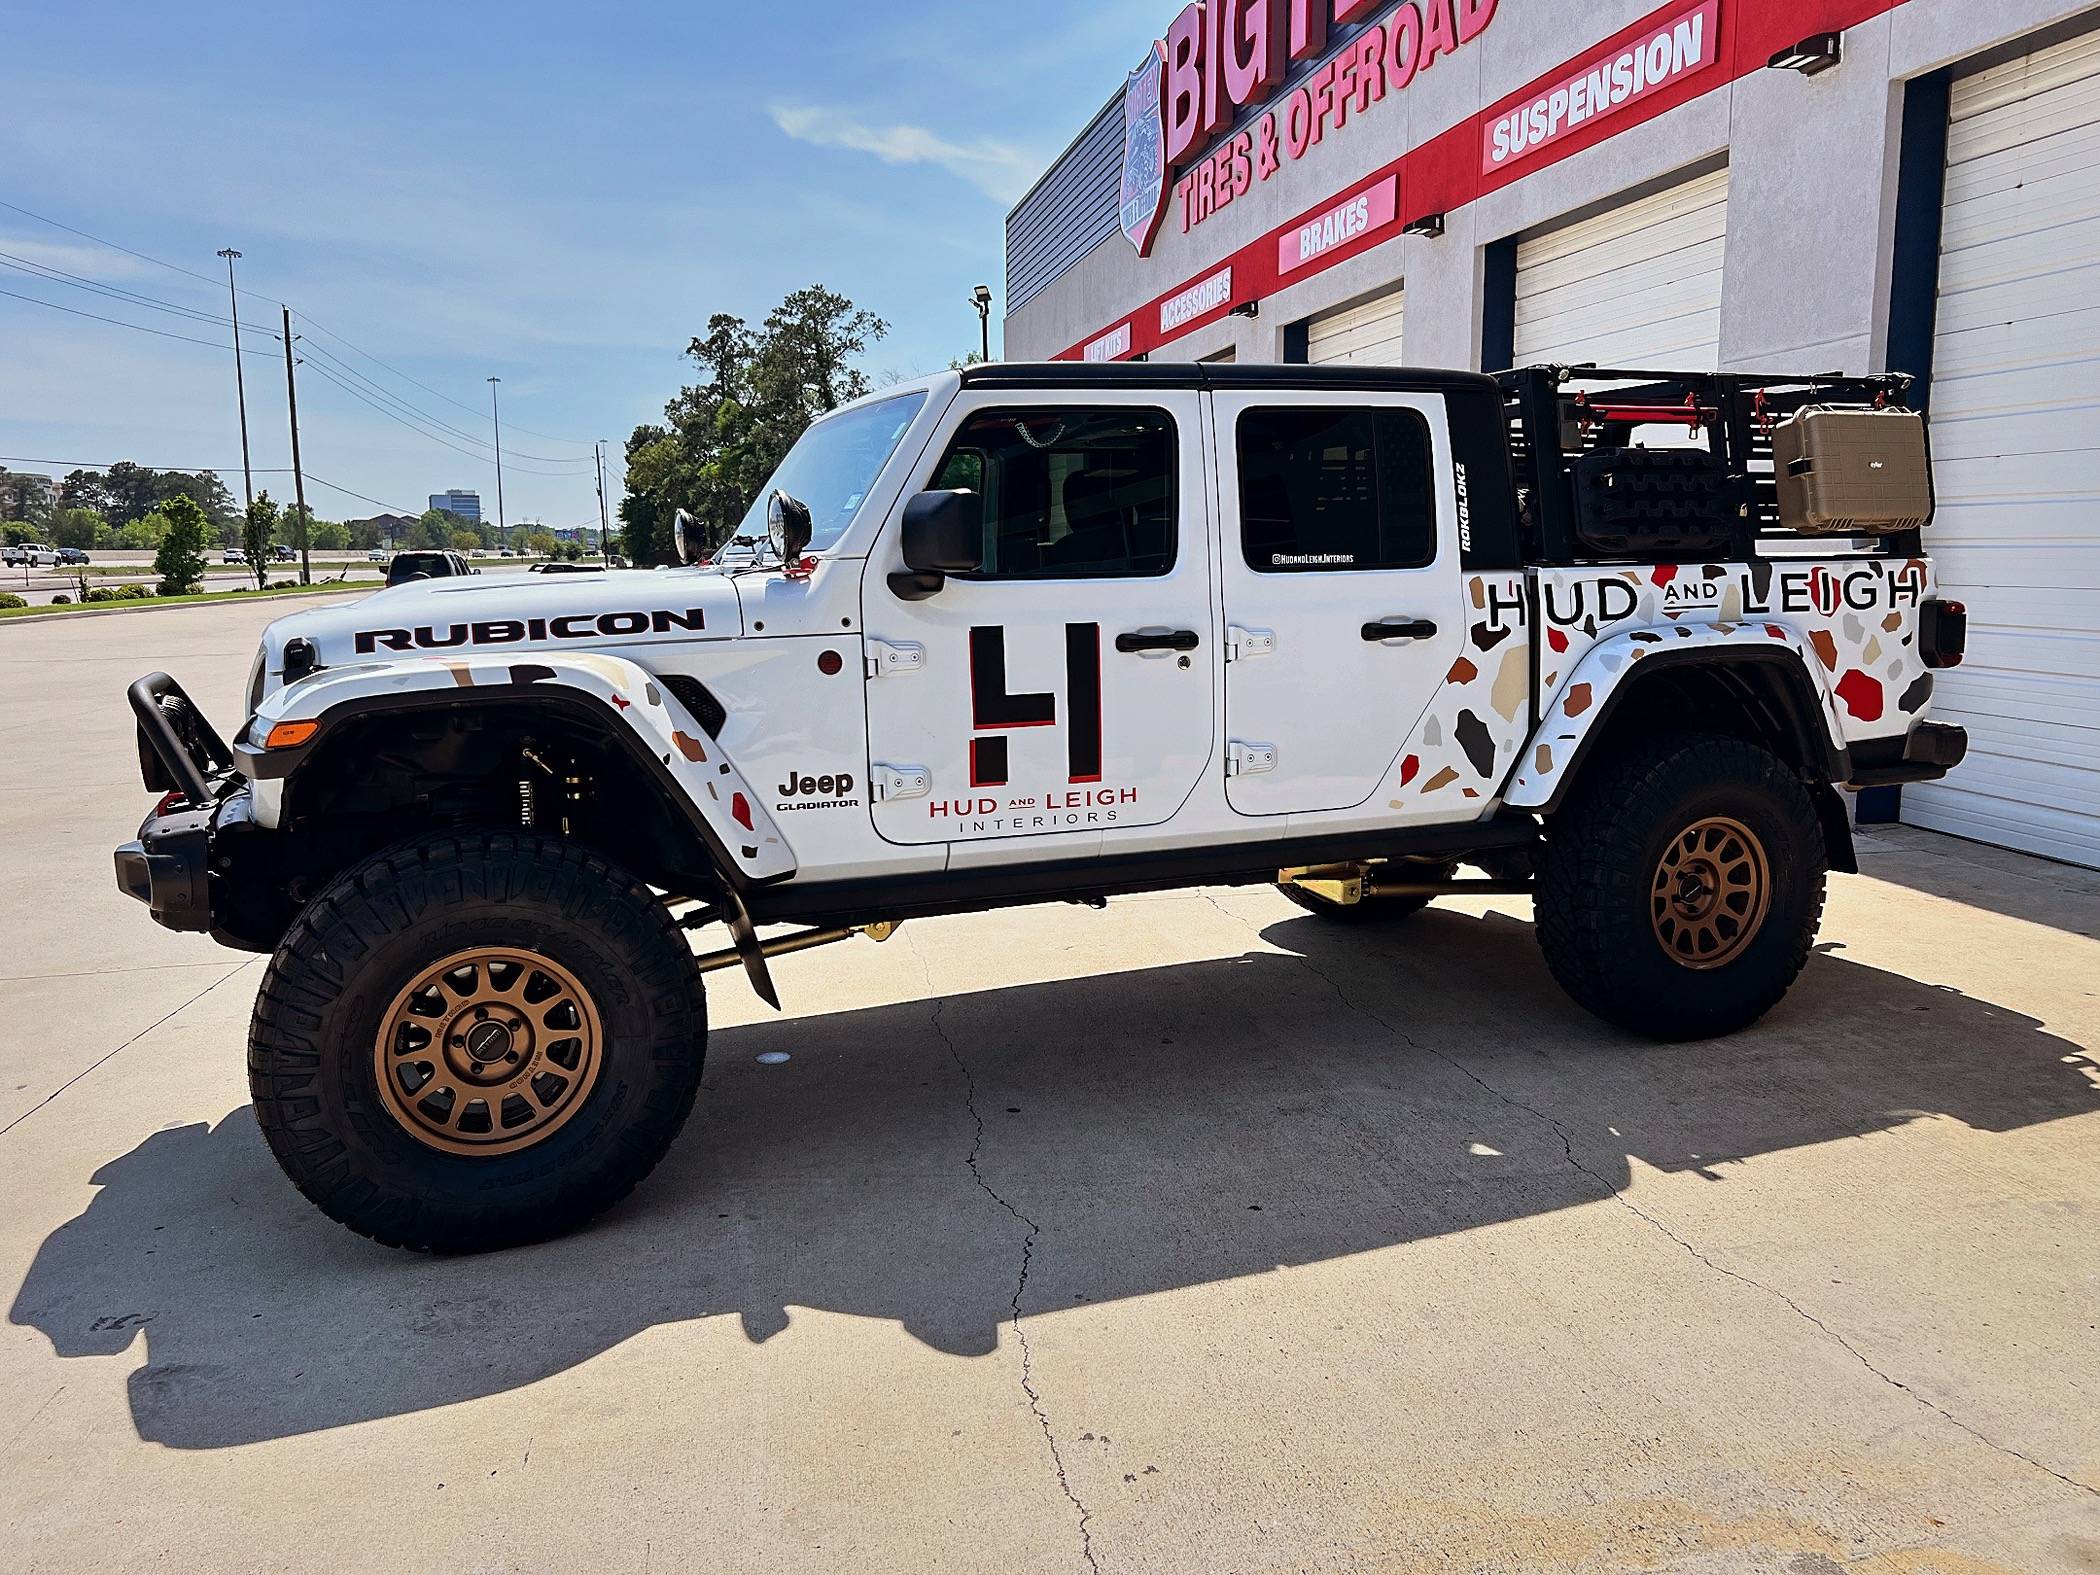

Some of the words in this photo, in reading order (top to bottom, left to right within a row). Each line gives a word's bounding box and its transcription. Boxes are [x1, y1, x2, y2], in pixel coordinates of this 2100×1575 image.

[1491, 12, 1704, 162] SUSPENSION
[1176, 131, 1253, 233] TIRES
[1256, 112, 1280, 181] &
[1300, 196, 1369, 260] BRAKES
[1162, 271, 1230, 329] ACCESSORIES
[1105, 330, 1122, 358] KITS
[1455, 462, 1471, 552] ROKBLOKZ
[1487, 577, 1639, 627] HUD
[1664, 582, 1718, 600] AND
[1741, 569, 1919, 614] LEIGH
[354, 608, 705, 654] RUBICON
[776, 799, 859, 811] GLADIATOR
[778, 771, 854, 797] Jeep
[929, 798, 998, 818] HUD
[1008, 797, 1036, 806] AND
[1046, 787, 1137, 810] LEIGH
[959, 810, 1117, 833] INTERIORS
